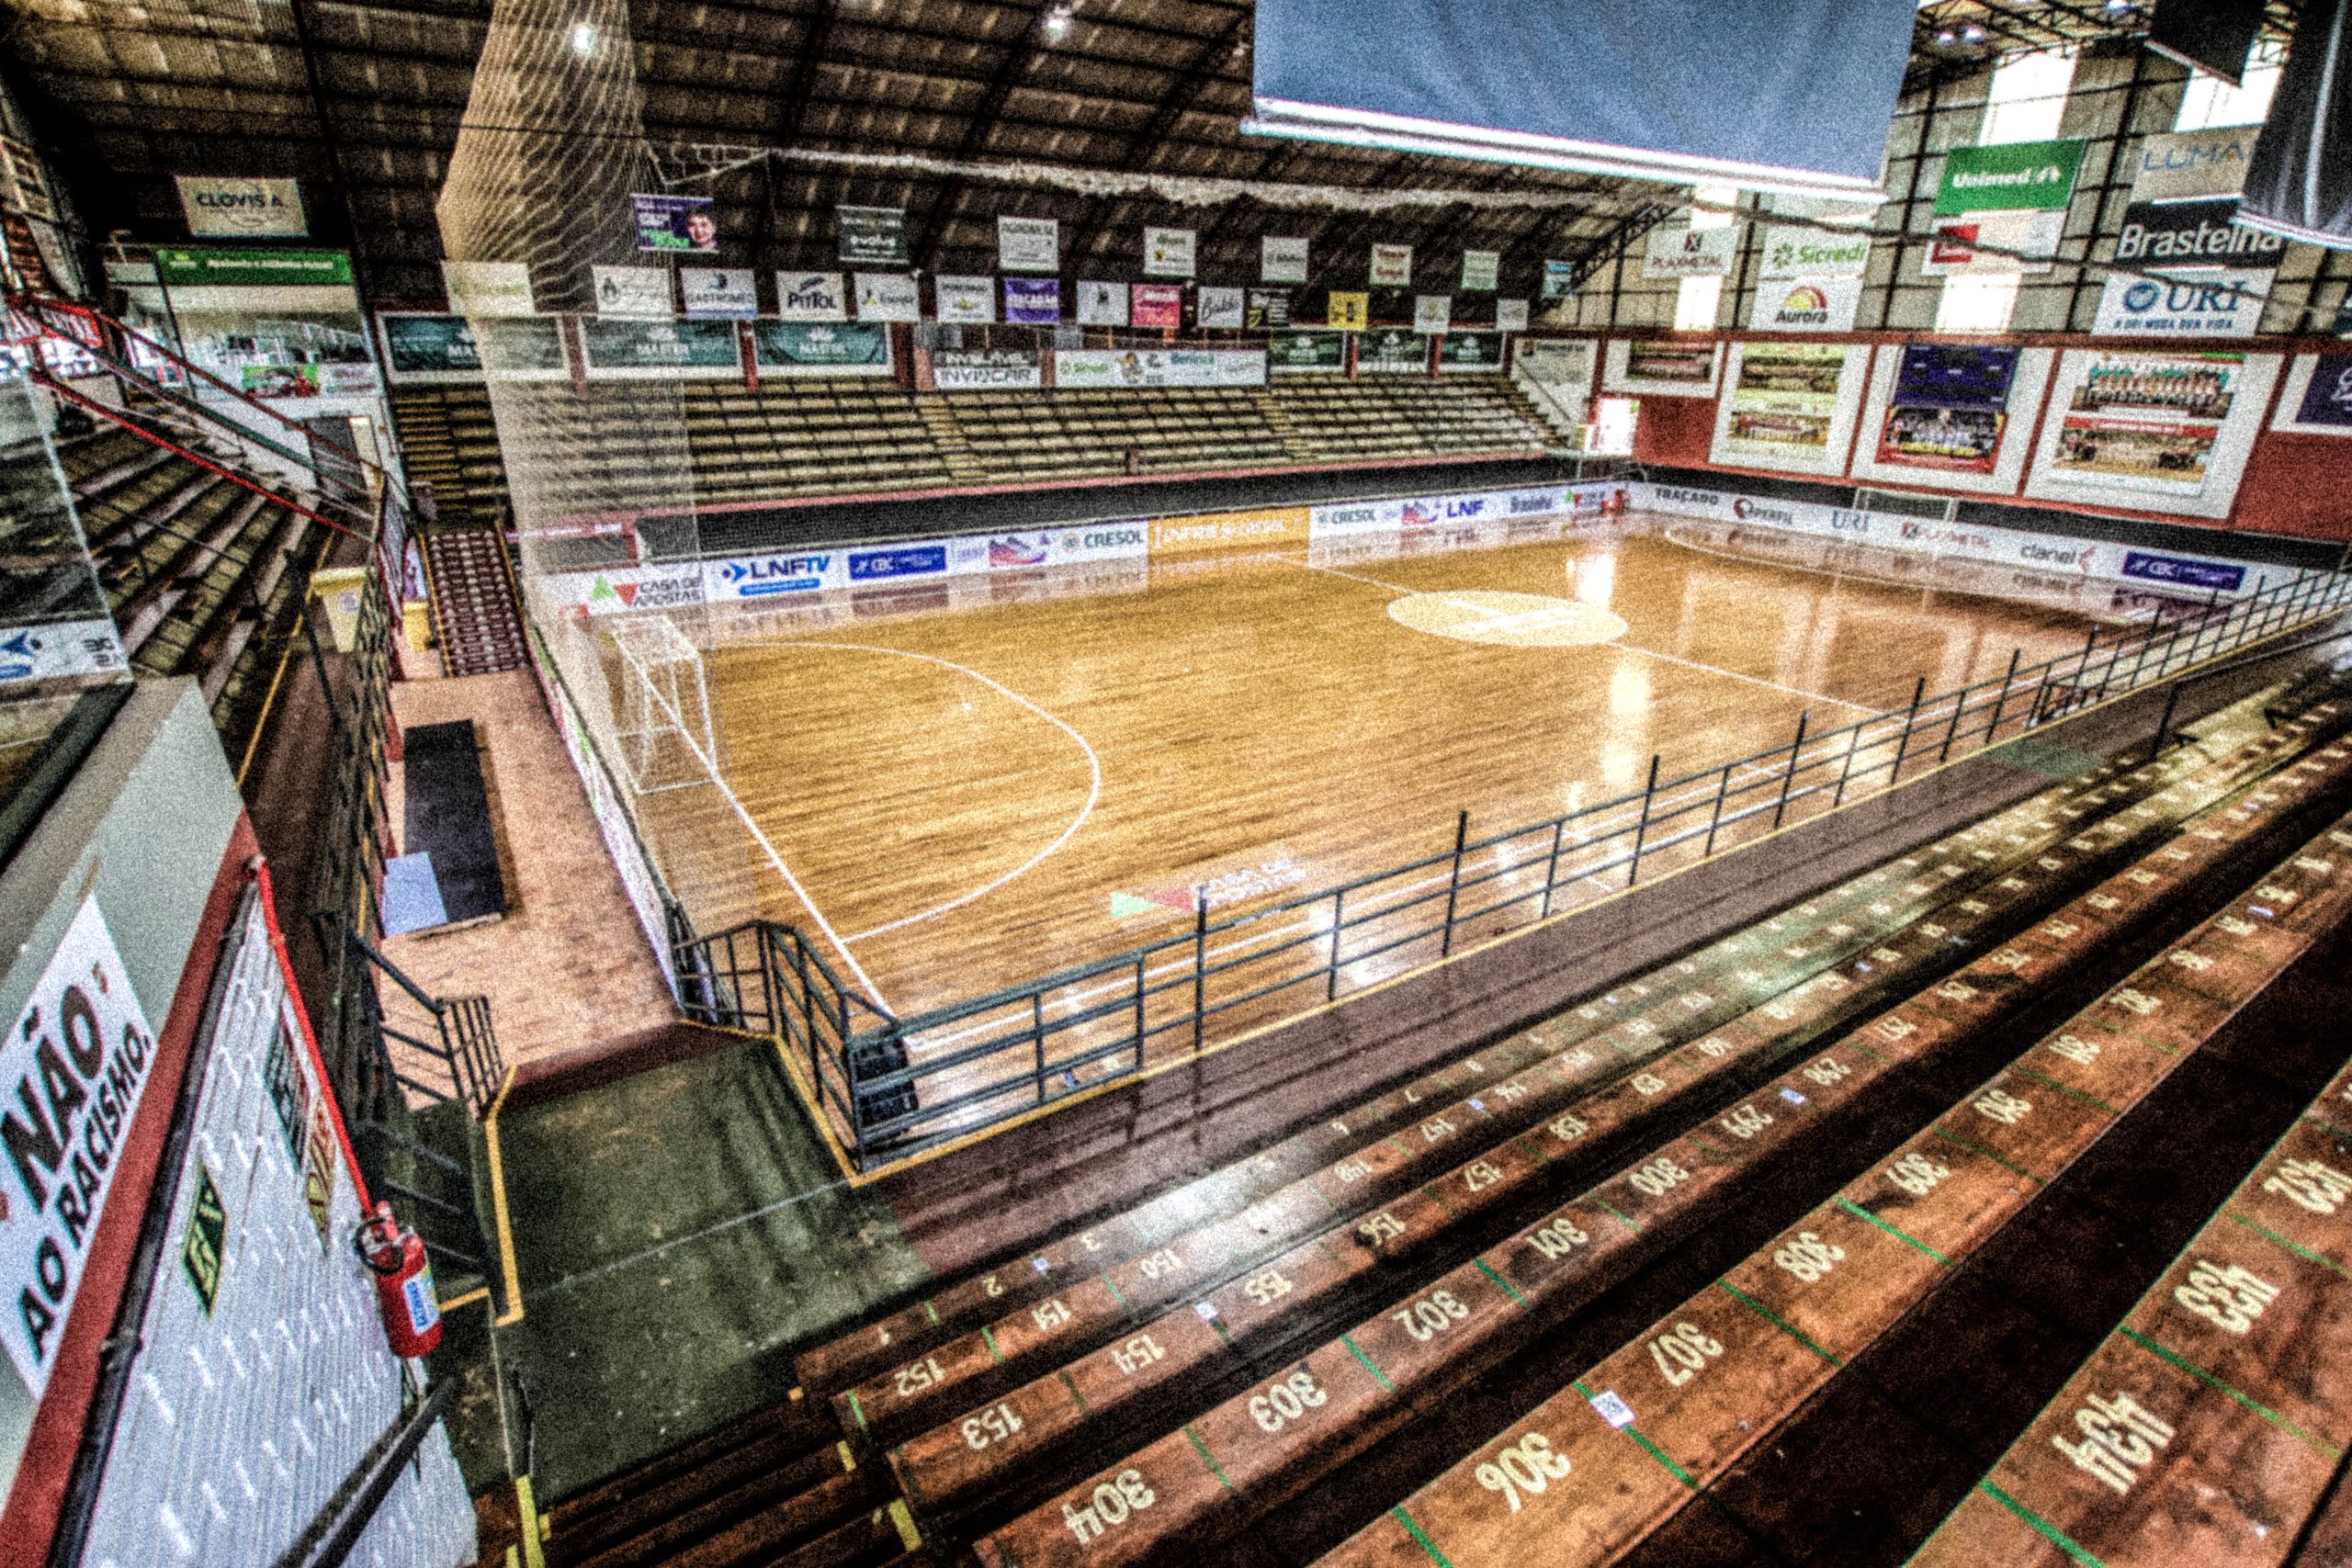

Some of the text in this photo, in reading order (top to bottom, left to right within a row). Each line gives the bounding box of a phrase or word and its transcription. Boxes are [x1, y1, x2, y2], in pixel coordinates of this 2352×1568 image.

[1952, 169, 2030, 188] Unimed
[196, 192, 266, 209] CLOVIS
[1798, 242, 1867, 263] Sicredi
[2165, 279, 2248, 312] URI
[1776, 310, 1828, 322] Aurora
[1446, 499, 1485, 518] LNF
[1084, 529, 1145, 548] CRESOL
[634, 590, 701, 608] APOSTAS
[639, 578, 681, 593] CASA
[1803, 1056, 1853, 1087] 298
[1, 983, 105, 1214] NÃO
[1404, 1088, 1422, 1105] 7
[1420, 1118, 1457, 1144] 147
[1720, 1102, 1775, 1141] 299
[16, 1021, 153, 1362] AO RACISMO.
[1462, 1161, 1505, 1194] 157
[1629, 1156, 1690, 1198] 300
[1884, 1151, 1951, 1196] 309
[1080, 1232, 1102, 1253] 3
[1524, 1216, 1589, 1261] 301
[1773, 1229, 1847, 1284] 308
[1140, 1248, 1183, 1280] 150
[981, 1275, 1005, 1298] 2
[1243, 1269, 1294, 1307] 155
[2173, 1258, 2281, 1336] 433
[1030, 1298, 1073, 1332] 151
[1392, 1288, 1472, 1343] 302
[1110, 1333, 1167, 1376] 154
[1648, 1321, 1725, 1389] 307
[895, 1356, 948, 1398] 152
[1248, 1371, 1330, 1434] 303
[960, 1403, 1026, 1452] 153
[2051, 1390, 2177, 1496] 434
[1475, 1430, 1573, 1514] 306
[1060, 1468, 1158, 1547] 304
